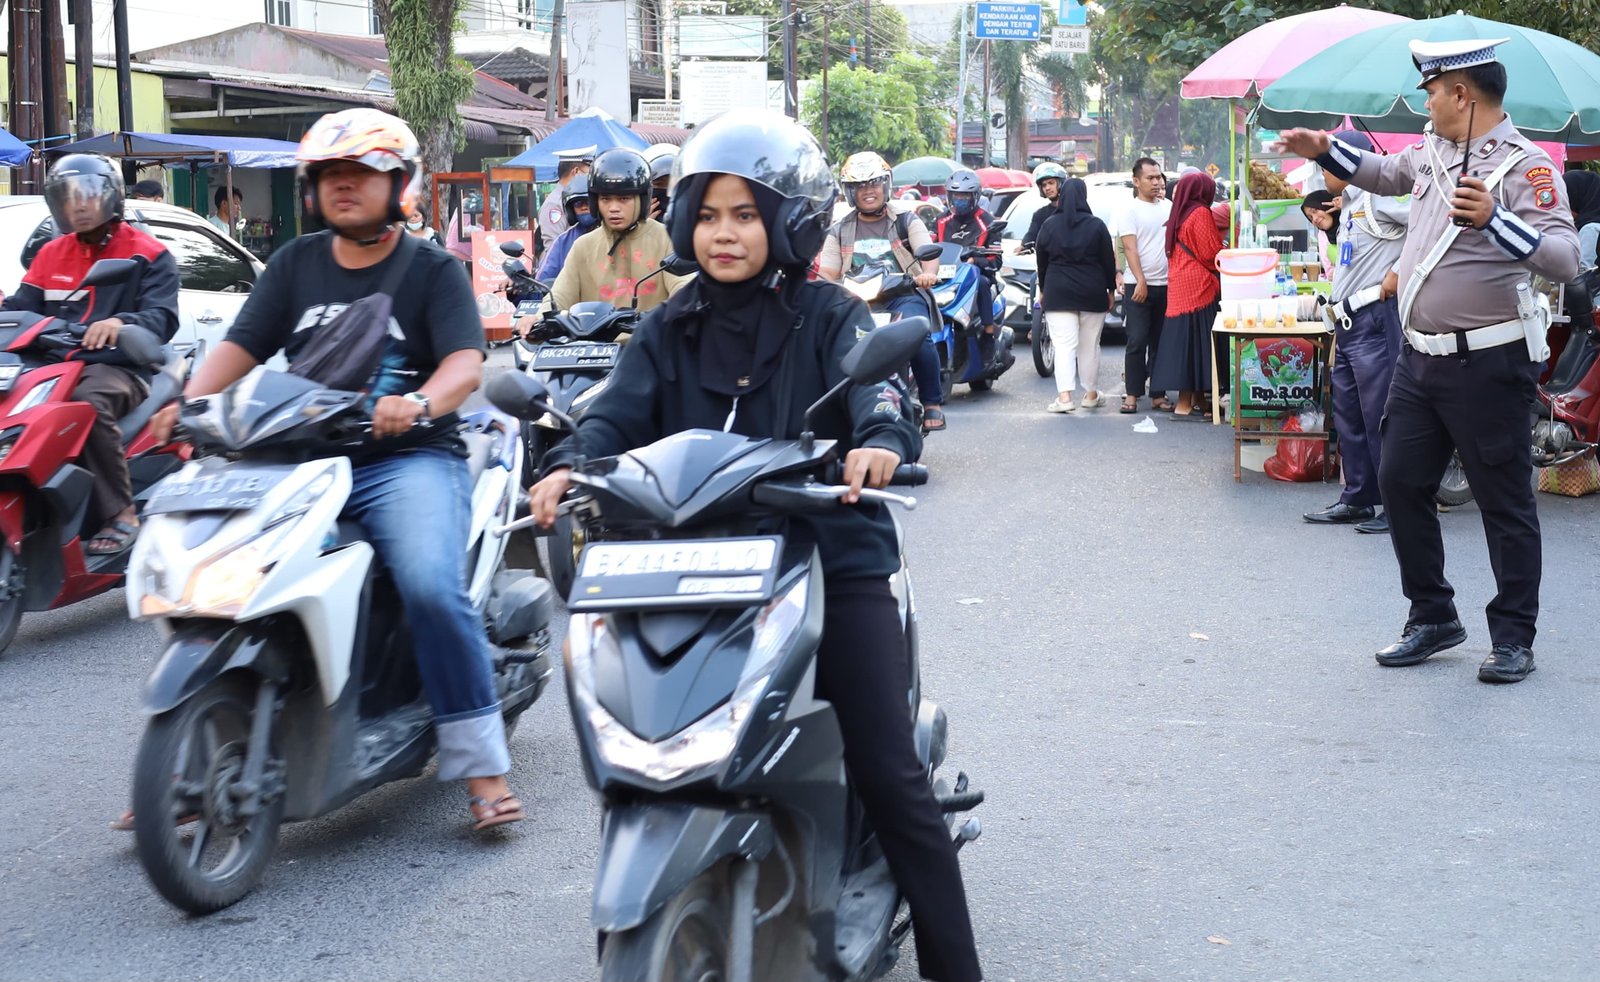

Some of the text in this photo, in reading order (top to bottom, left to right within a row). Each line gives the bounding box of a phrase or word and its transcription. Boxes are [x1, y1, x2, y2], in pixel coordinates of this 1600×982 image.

[979, 12, 1019, 20] KENDARAAN
[1001, 28, 1029, 36] TERATUR
[1527, 167, 1551, 178] POLDA
